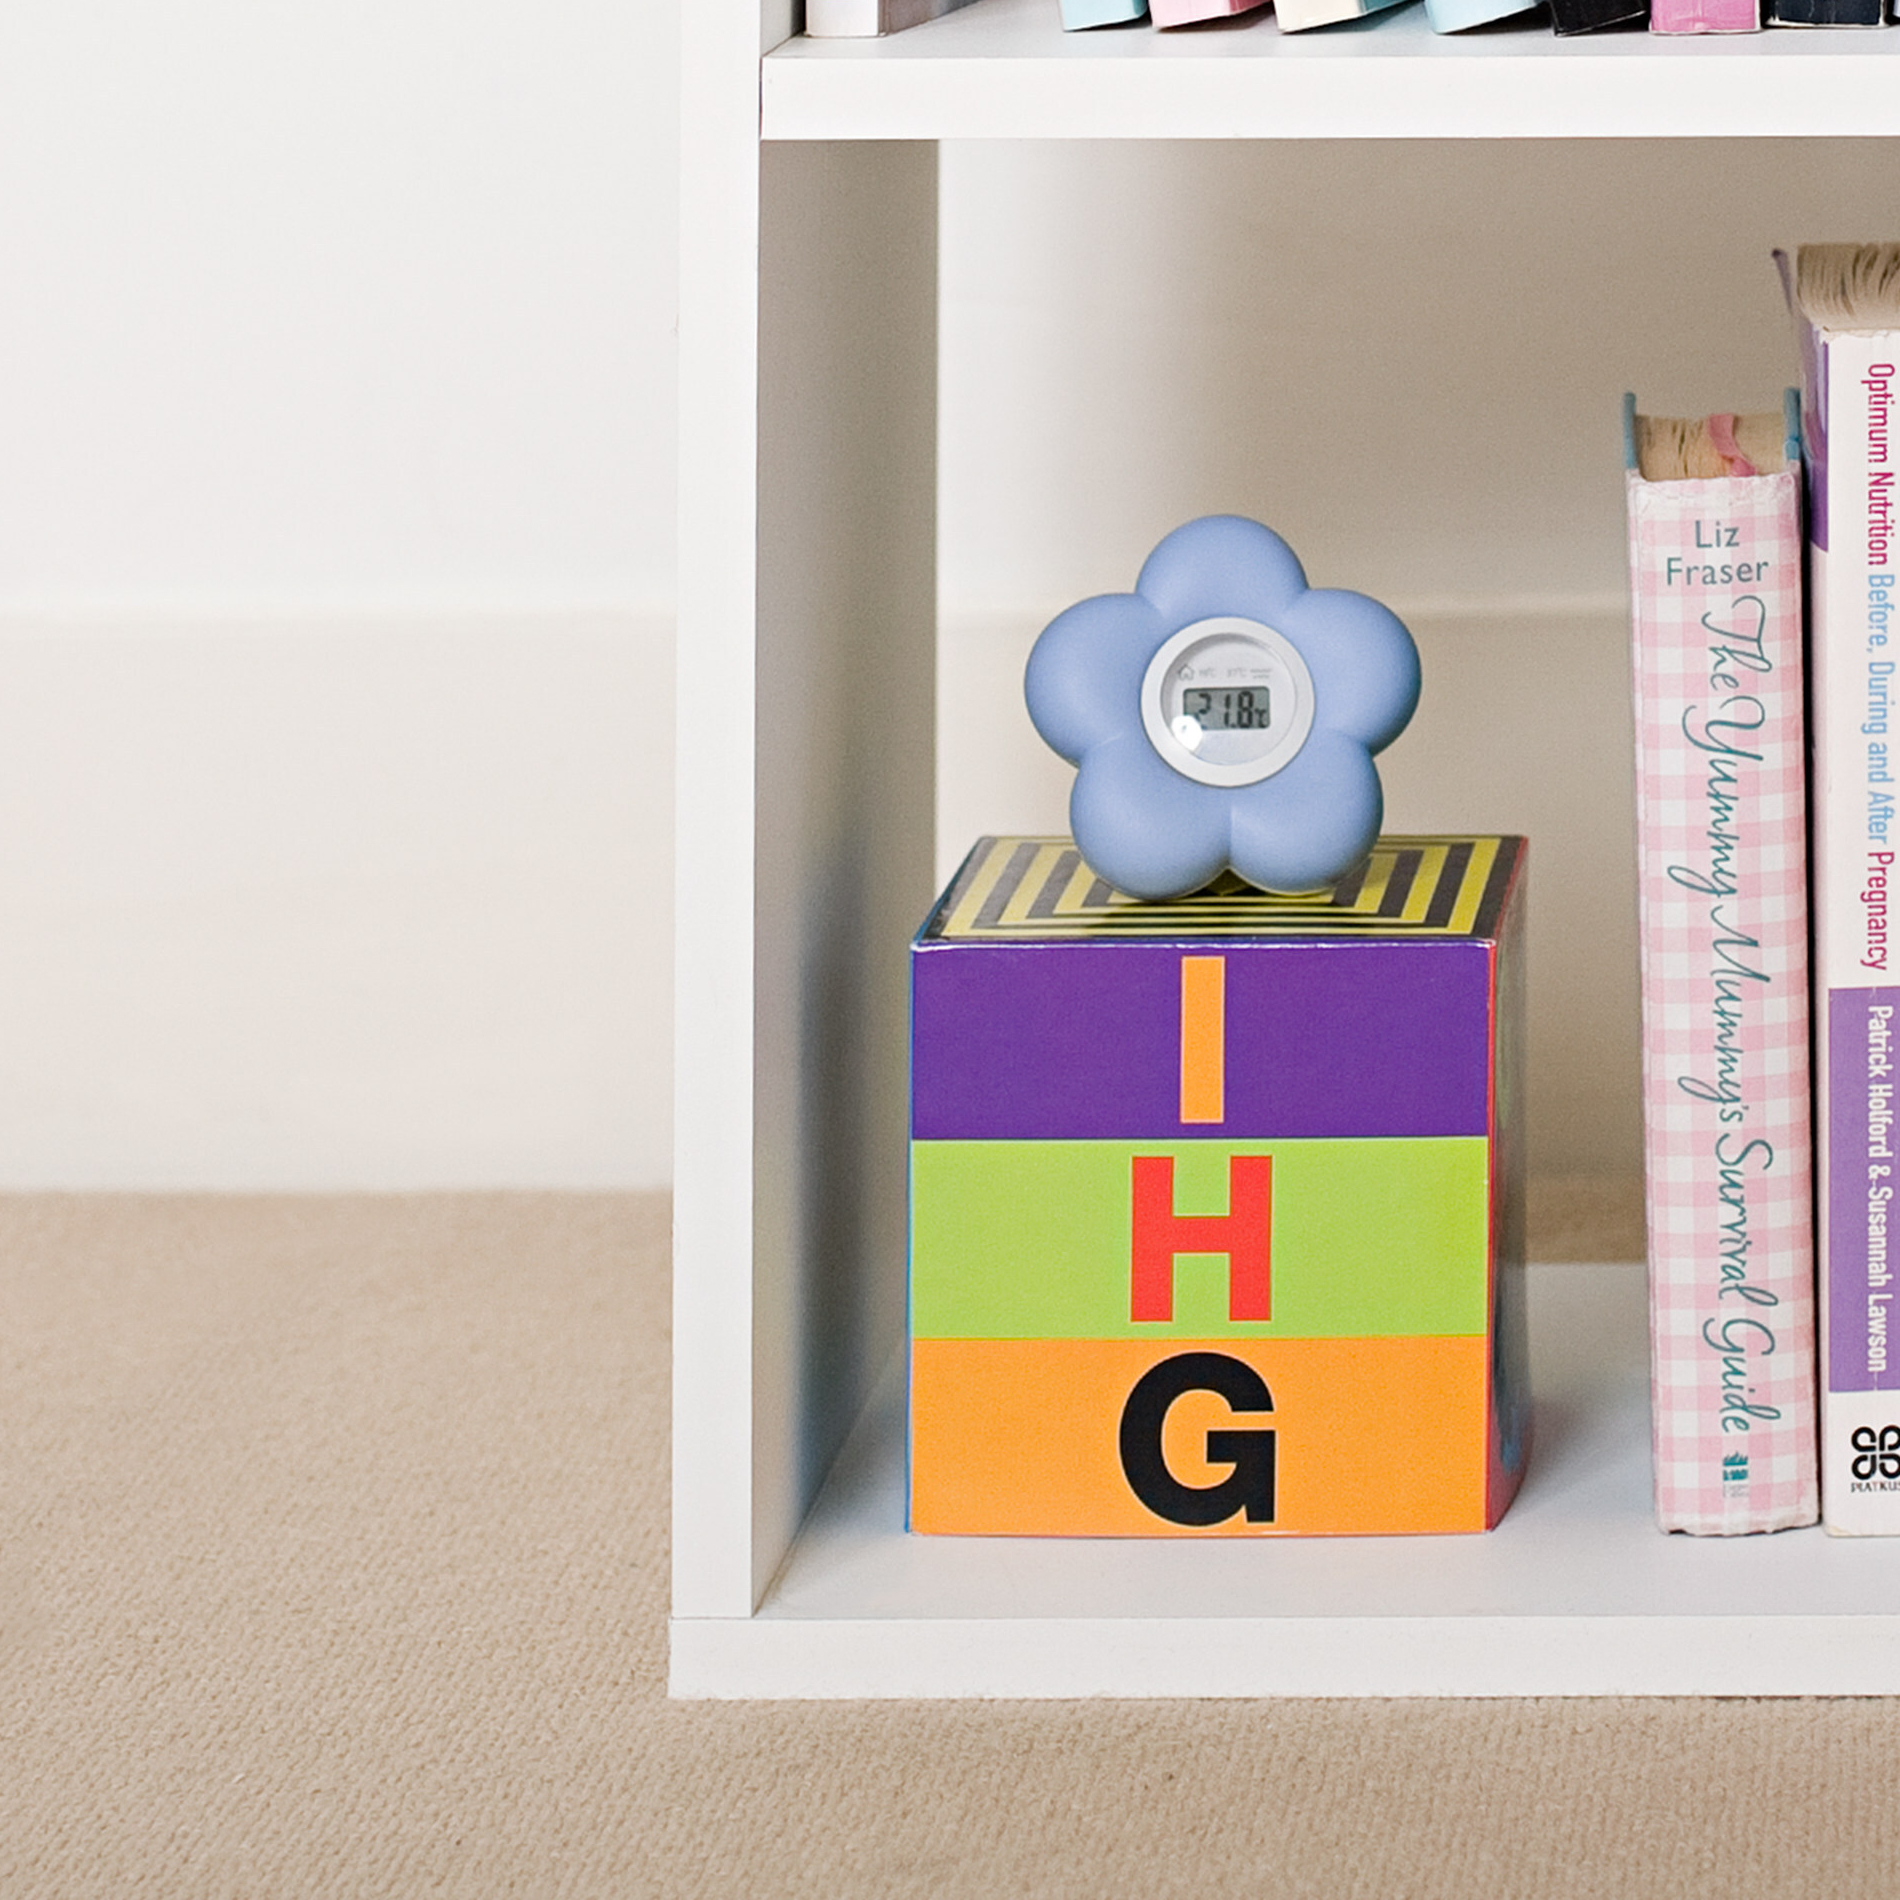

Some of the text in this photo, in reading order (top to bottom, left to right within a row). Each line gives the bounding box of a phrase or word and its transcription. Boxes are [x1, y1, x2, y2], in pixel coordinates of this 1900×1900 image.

[1665, 556, 1770, 587] Fraser
[1694, 520, 1740, 549] Liz
[1860, 362, 1897, 972] Optimum Nutrition Before, During and After Pregnancy
[1179, 954, 1226, 1124] I
[1667, 595, 1782, 1433] The Yummy Mummy's Survival Guide
[1129, 1154, 1273, 1323] H
[1866, 1004, 1895, 1373] Patrick Holford & Susannah Lawson
[1117, 1350, 1276, 1528] G
